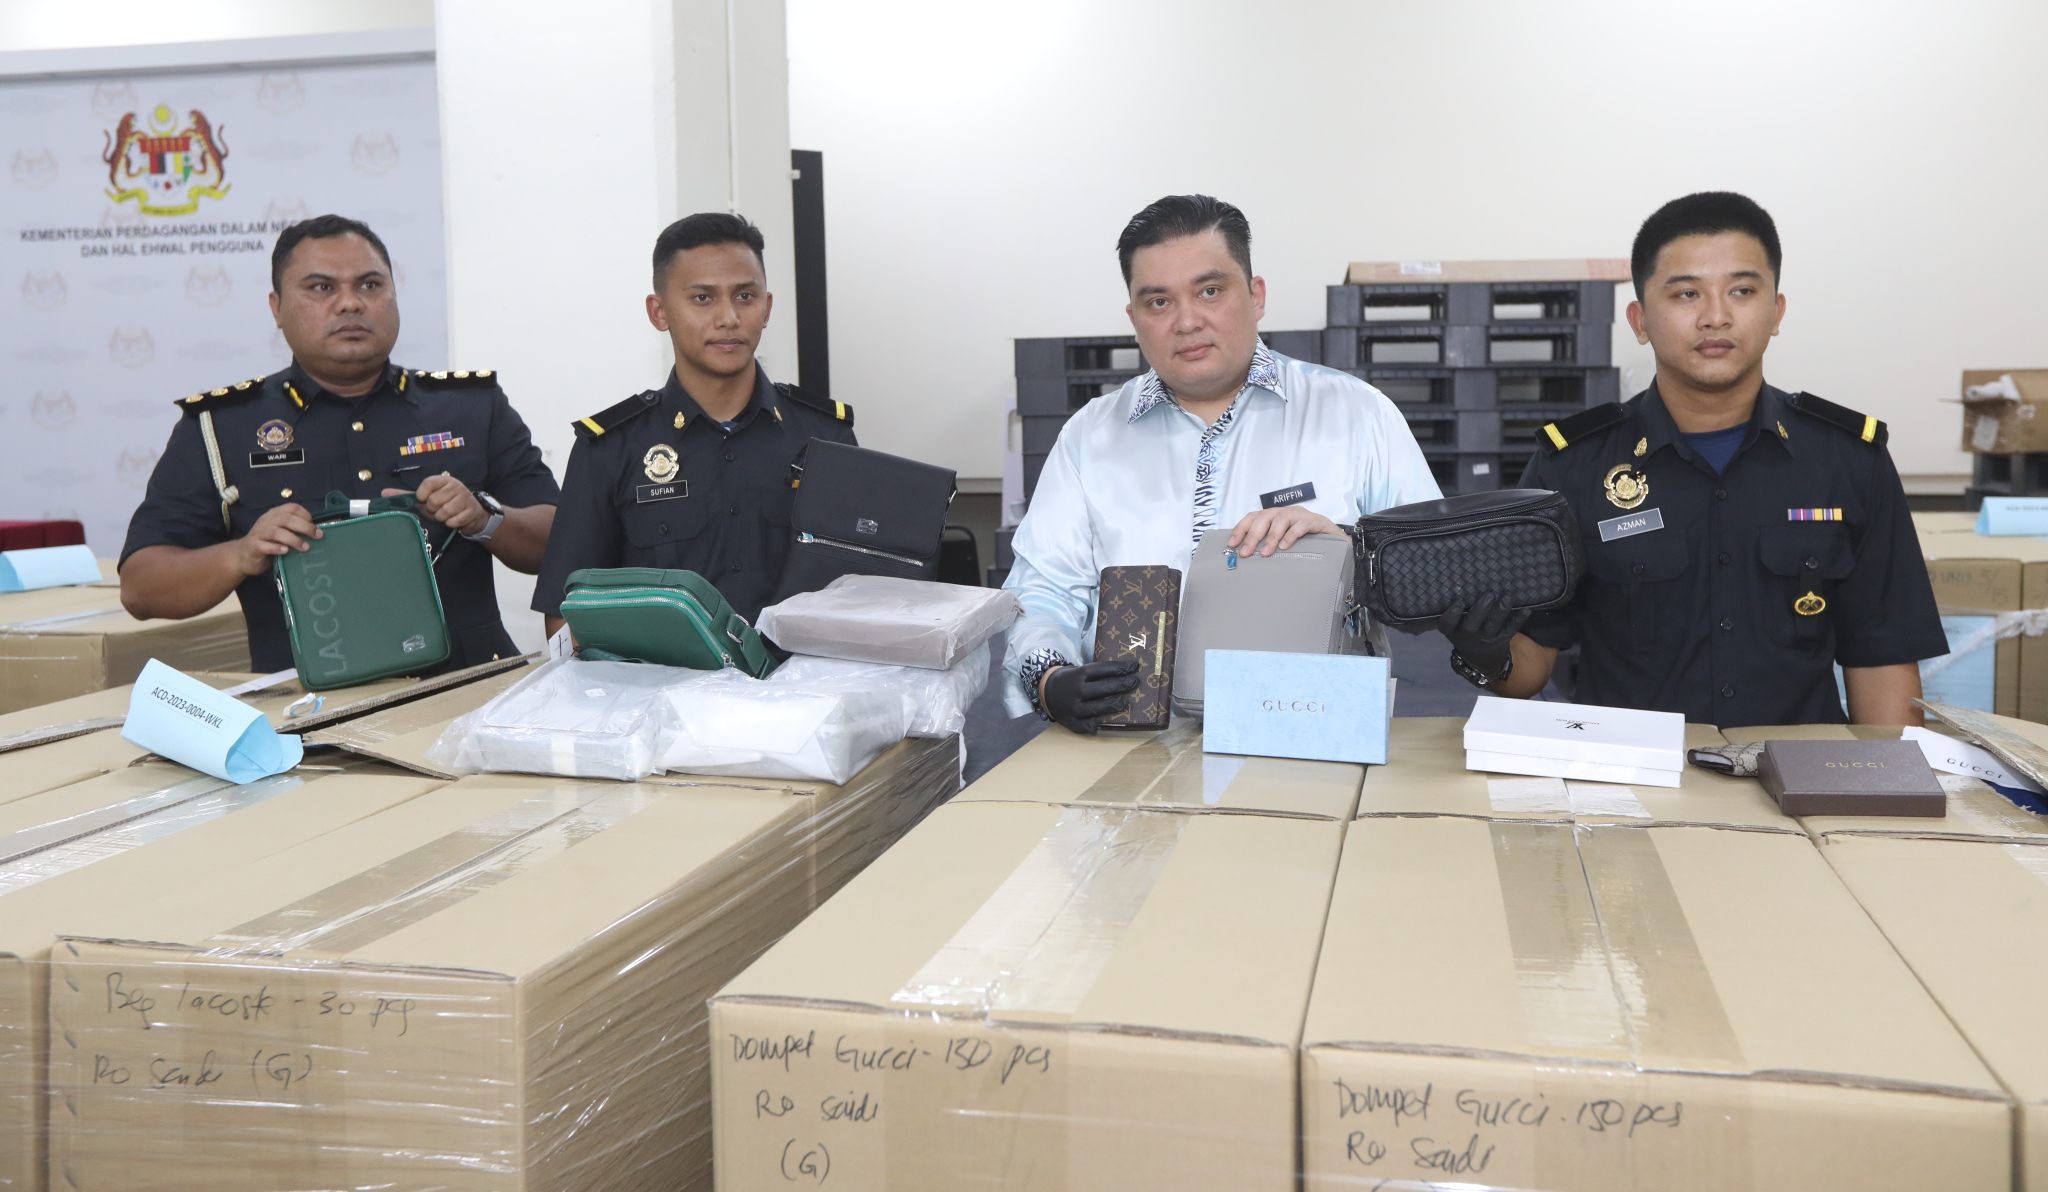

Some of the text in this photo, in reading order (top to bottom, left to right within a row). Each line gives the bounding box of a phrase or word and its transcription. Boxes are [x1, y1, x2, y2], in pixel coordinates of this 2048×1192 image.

[21, 227, 112, 242] KEMENTERIAN
[116, 222, 218, 239] PERDAGANGAN
[220, 221, 268, 235] DALAM
[81, 239, 264, 258] DAN HAL EHWAL PENGGUNA
[650, 486, 675, 496] SUFIAN
[1273, 490, 1304, 504] ARIFFIN
[1617, 518, 1647, 532] AZMAN
[151, 686, 224, 729] ACD-2023-0004-WKL
[1262, 699, 1326, 713] GUCCI
[1825, 761, 1886, 769] GUCCI
[1946, 757, 2003, 779] GUCCI
[319, 991, 355, 1016] 30
[730, 1030, 815, 1072] Dompet
[1333, 1077, 1432, 1127] Dompet
[781, 1138, 831, 1186] (G)
